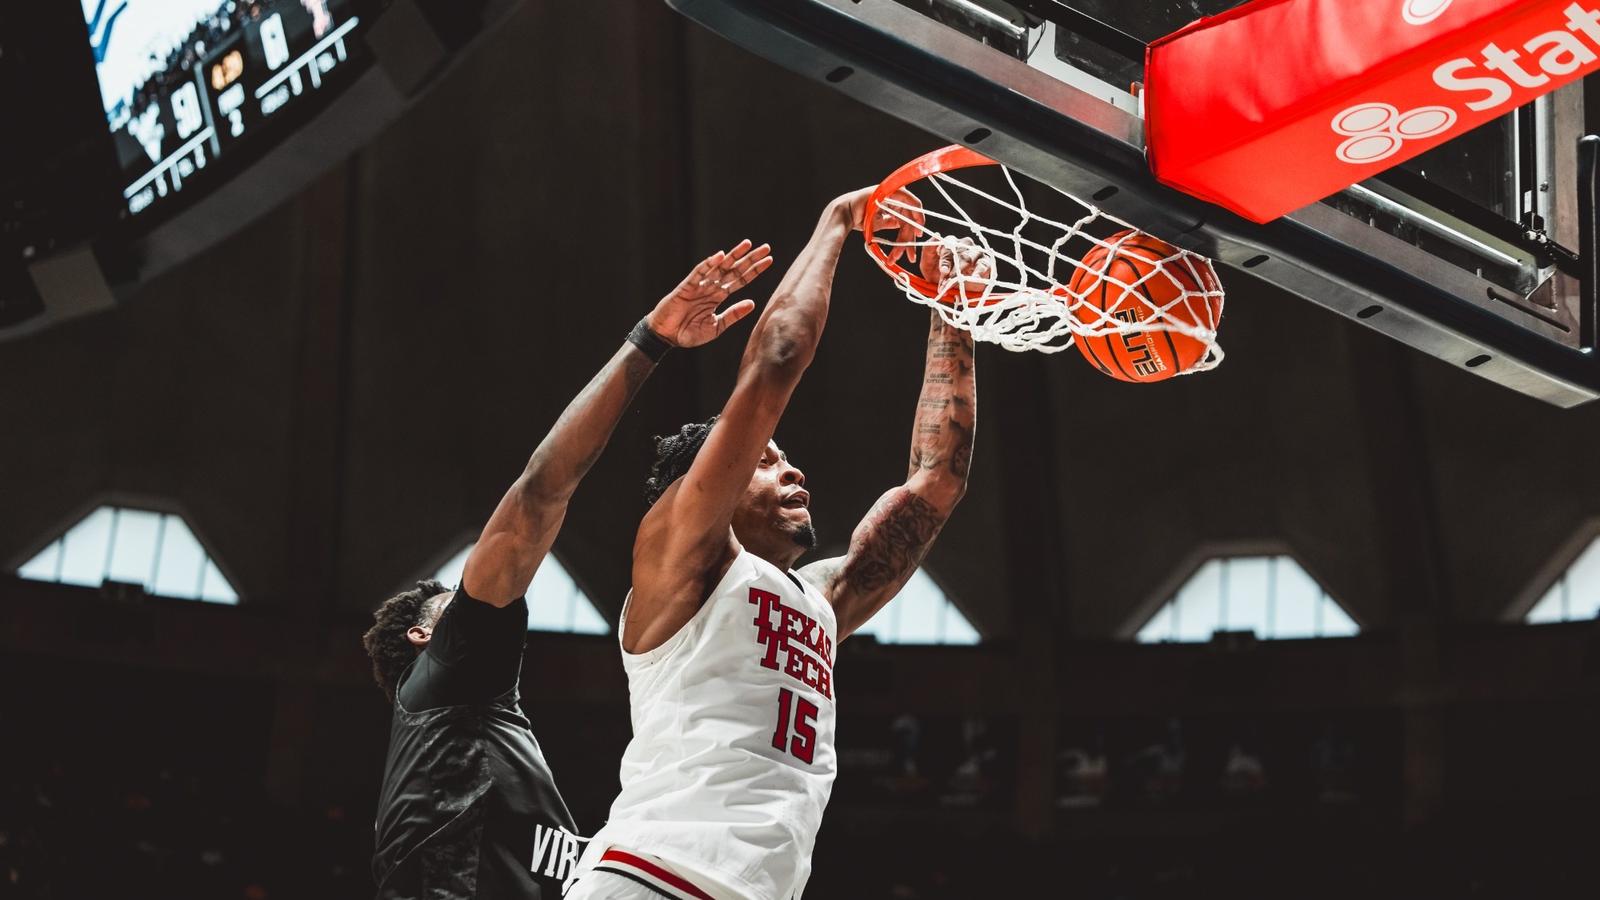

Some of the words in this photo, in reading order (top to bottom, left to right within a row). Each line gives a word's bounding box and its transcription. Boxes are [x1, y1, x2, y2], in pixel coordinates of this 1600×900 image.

[749, 586, 832, 669] TEXAS
[757, 626, 832, 701] TECH
[771, 687, 819, 765] 15
